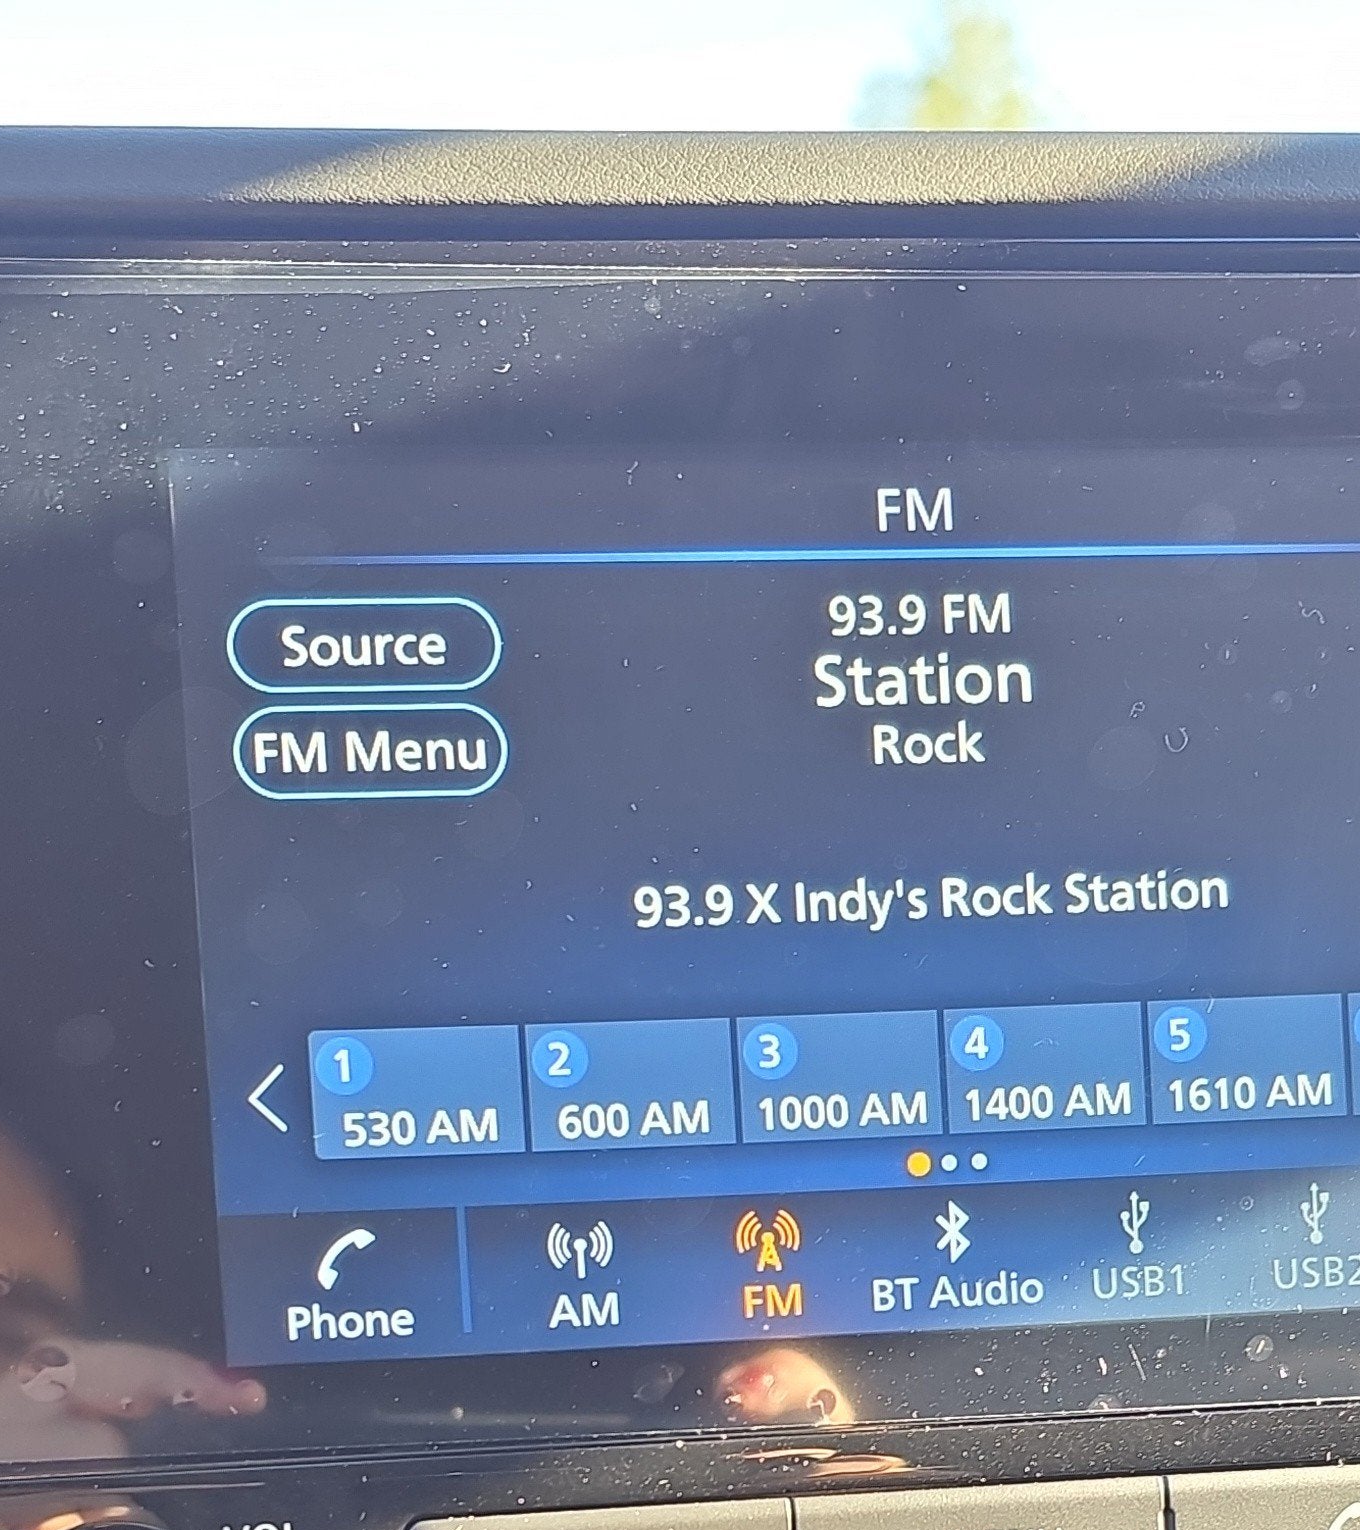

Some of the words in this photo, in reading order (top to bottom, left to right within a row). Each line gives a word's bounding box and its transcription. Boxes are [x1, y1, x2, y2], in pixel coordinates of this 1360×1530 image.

[876, 487, 954, 533] FM
[827, 596, 927, 637] 93.9
[943, 594, 1012, 634] FM
[281, 625, 447, 668] Source
[814, 654, 1033, 708] Station
[253, 732, 327, 774] FM
[346, 730, 487, 771] Menu
[872, 722, 985, 765] Rock
[632, 885, 733, 928] 93.9
[746, 883, 781, 924] X
[795, 876, 928, 931] Indy's
[942, 871, 1053, 918] Rock
[1065, 870, 1230, 913] Station
[758, 1034, 781, 1069] 3
[965, 1027, 988, 1060] 4
[1169, 1018, 1190, 1052] 5
[333, 1051, 351, 1082] 1
[547, 1043, 571, 1076] 2
[758, 1095, 849, 1131] 1000
[859, 1092, 928, 1127] AM
[964, 1087, 1054, 1122] 1400
[1064, 1082, 1132, 1118] AM
[1168, 1077, 1257, 1113] 1610
[1266, 1073, 1333, 1109] AM
[343, 1112, 415, 1148] 530
[426, 1108, 498, 1143] AM
[557, 1103, 629, 1140] 600
[639, 1100, 710, 1135] AM
[744, 1283, 801, 1318] FM
[872, 1277, 919, 1313] BT
[930, 1271, 1043, 1310] Audio
[1093, 1263, 1186, 1301] USB1
[287, 1303, 414, 1341] Phone
[548, 1293, 620, 1329] AM
